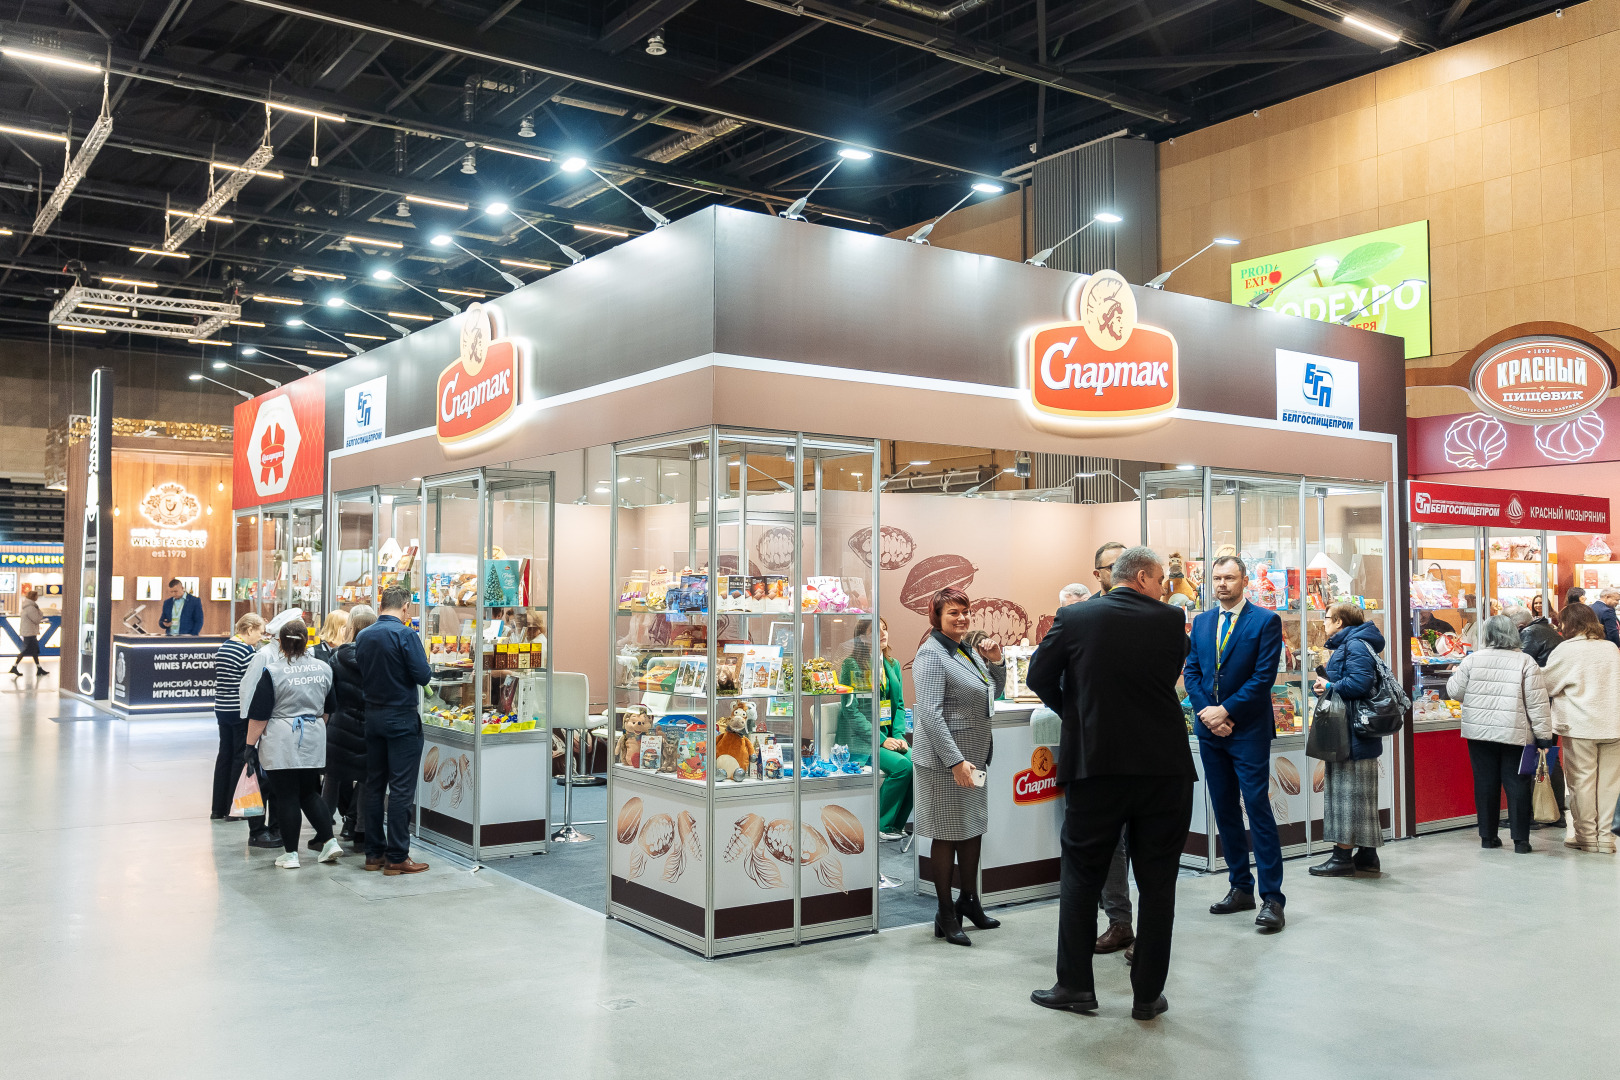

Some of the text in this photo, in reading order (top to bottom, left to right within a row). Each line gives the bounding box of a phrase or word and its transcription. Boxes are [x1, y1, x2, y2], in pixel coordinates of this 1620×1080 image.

[1241, 263, 1273, 280] PROD
[1040, 336, 1169, 396] Спартак
[1497, 356, 1588, 389] КРАСНЫЙ
[1304, 363, 1332, 408] БГП
[441, 368, 511, 423] Спартак
[1282, 412, 1354, 431] БЕЛГОСПИЩЕПРОМ
[1430, 503, 1500, 517] БЕЛГОСПИЩЕПРОМ
[1530, 505, 1607, 524] КРАСНЫЙ МОЗЫРЯНИН
[153, 653, 179, 661] MINSK
[153, 661, 217, 671] WINES FACTOR
[283, 664, 324, 674] СЛУЖБА
[152, 680, 193, 689] МИНСКИЙ
[287, 675, 325, 687] УБОРКИ
[152, 689, 200, 699] ИГРИСТЫХ
[1016, 772, 1057, 796] Спарт
